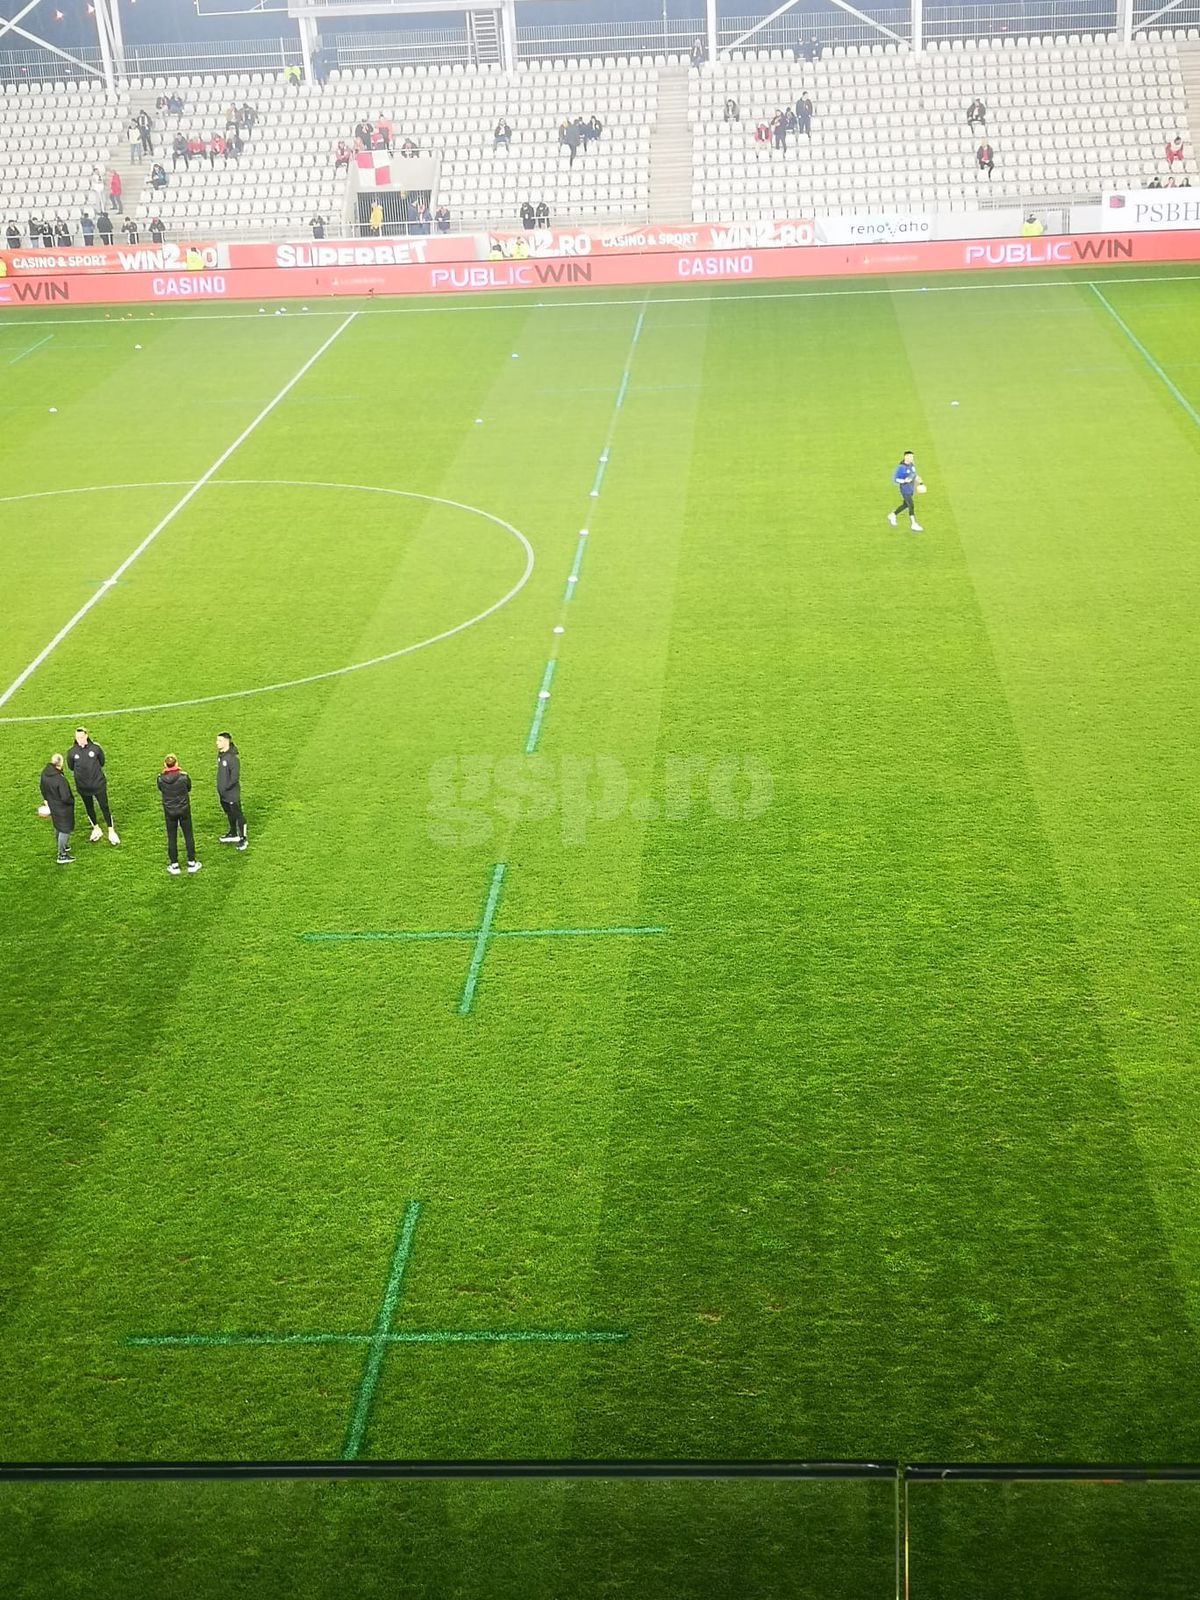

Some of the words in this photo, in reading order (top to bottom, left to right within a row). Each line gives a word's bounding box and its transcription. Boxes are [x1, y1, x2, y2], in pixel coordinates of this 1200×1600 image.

[1135, 201, 1200, 223] PSBH
[490, 228, 591, 258] W2.RO
[601, 234, 645, 247] CASINO
[647, 233, 656, 246] &
[658, 231, 699, 246] SPORT
[12, 256, 54, 269] CASINO
[57, 257, 67, 268] &
[68, 254, 107, 267] SPORT
[276, 240, 428, 267] SUPERBET
[677, 255, 753, 276] CASINO
[153, 276, 226, 296] CASINO
